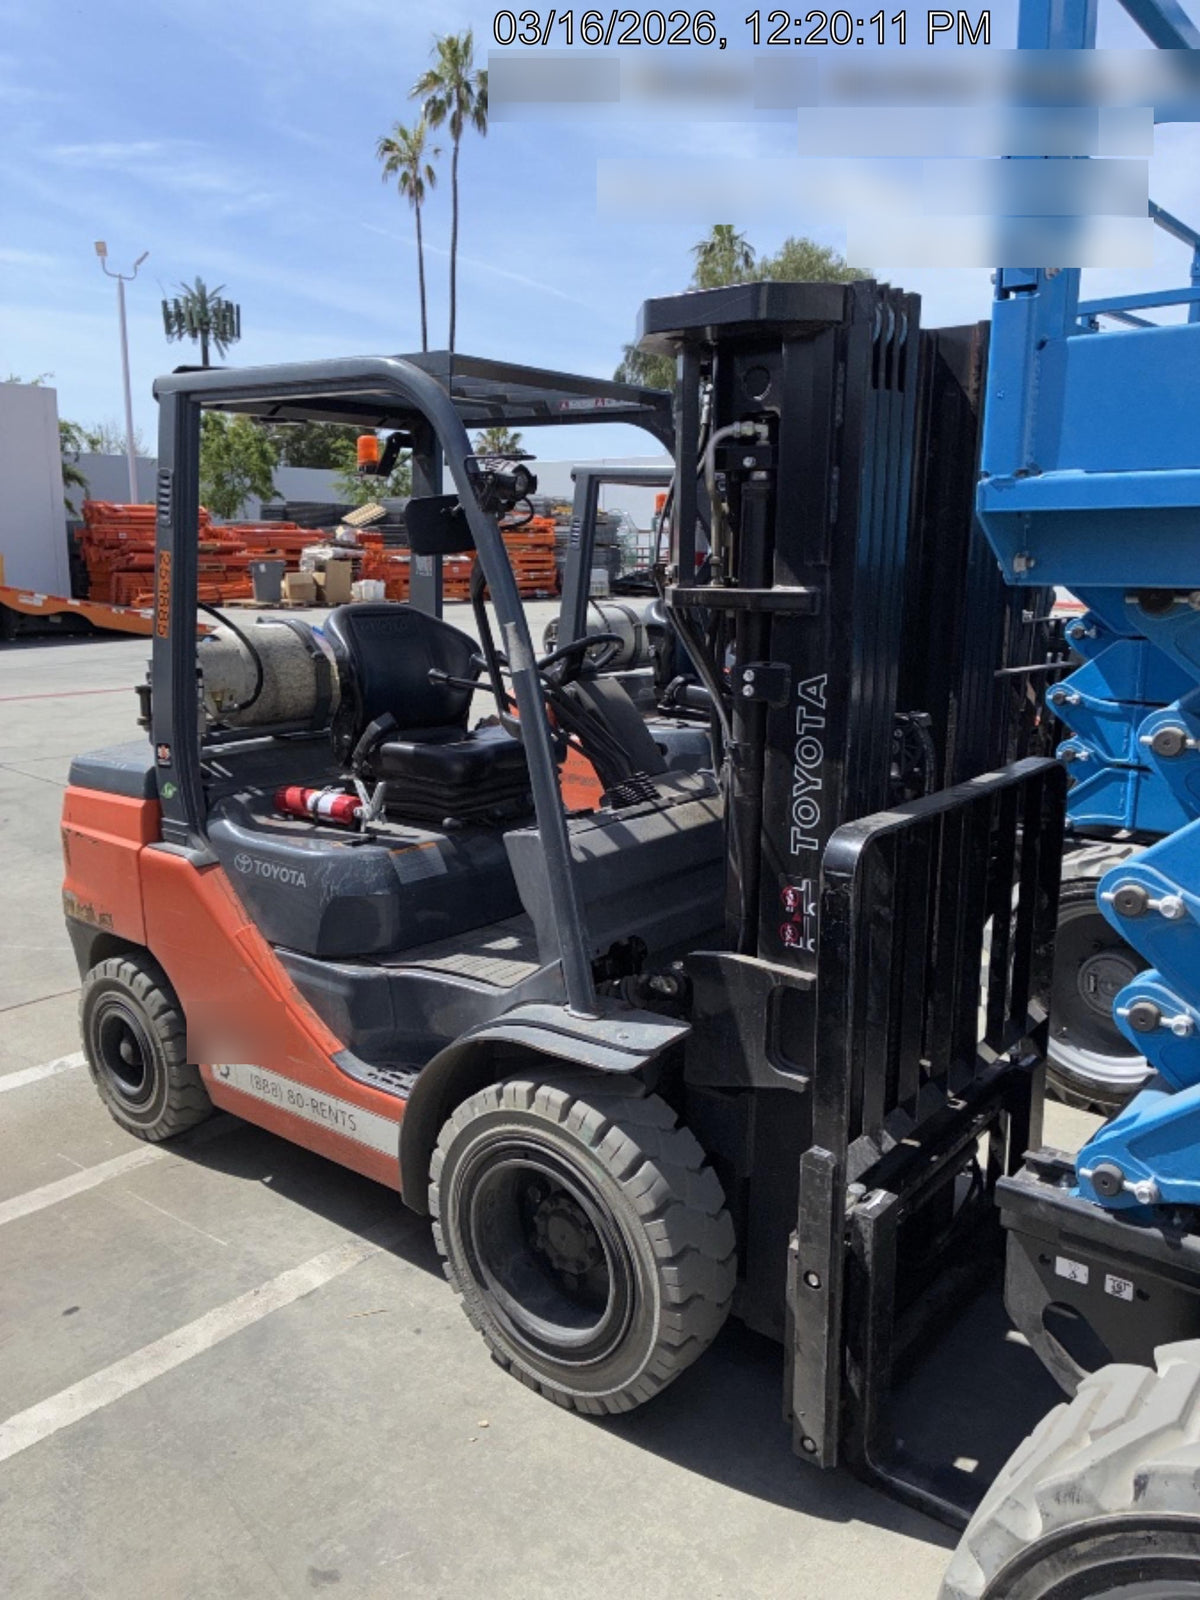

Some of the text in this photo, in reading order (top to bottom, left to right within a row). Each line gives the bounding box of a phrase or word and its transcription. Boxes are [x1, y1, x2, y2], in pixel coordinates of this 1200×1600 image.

[791, 673, 828, 855] TOYOTA
[254, 860, 307, 888] TOYOTA
[250, 1072, 284, 1102] (888)
[287, 1088, 357, 1132] 80-RENTS
